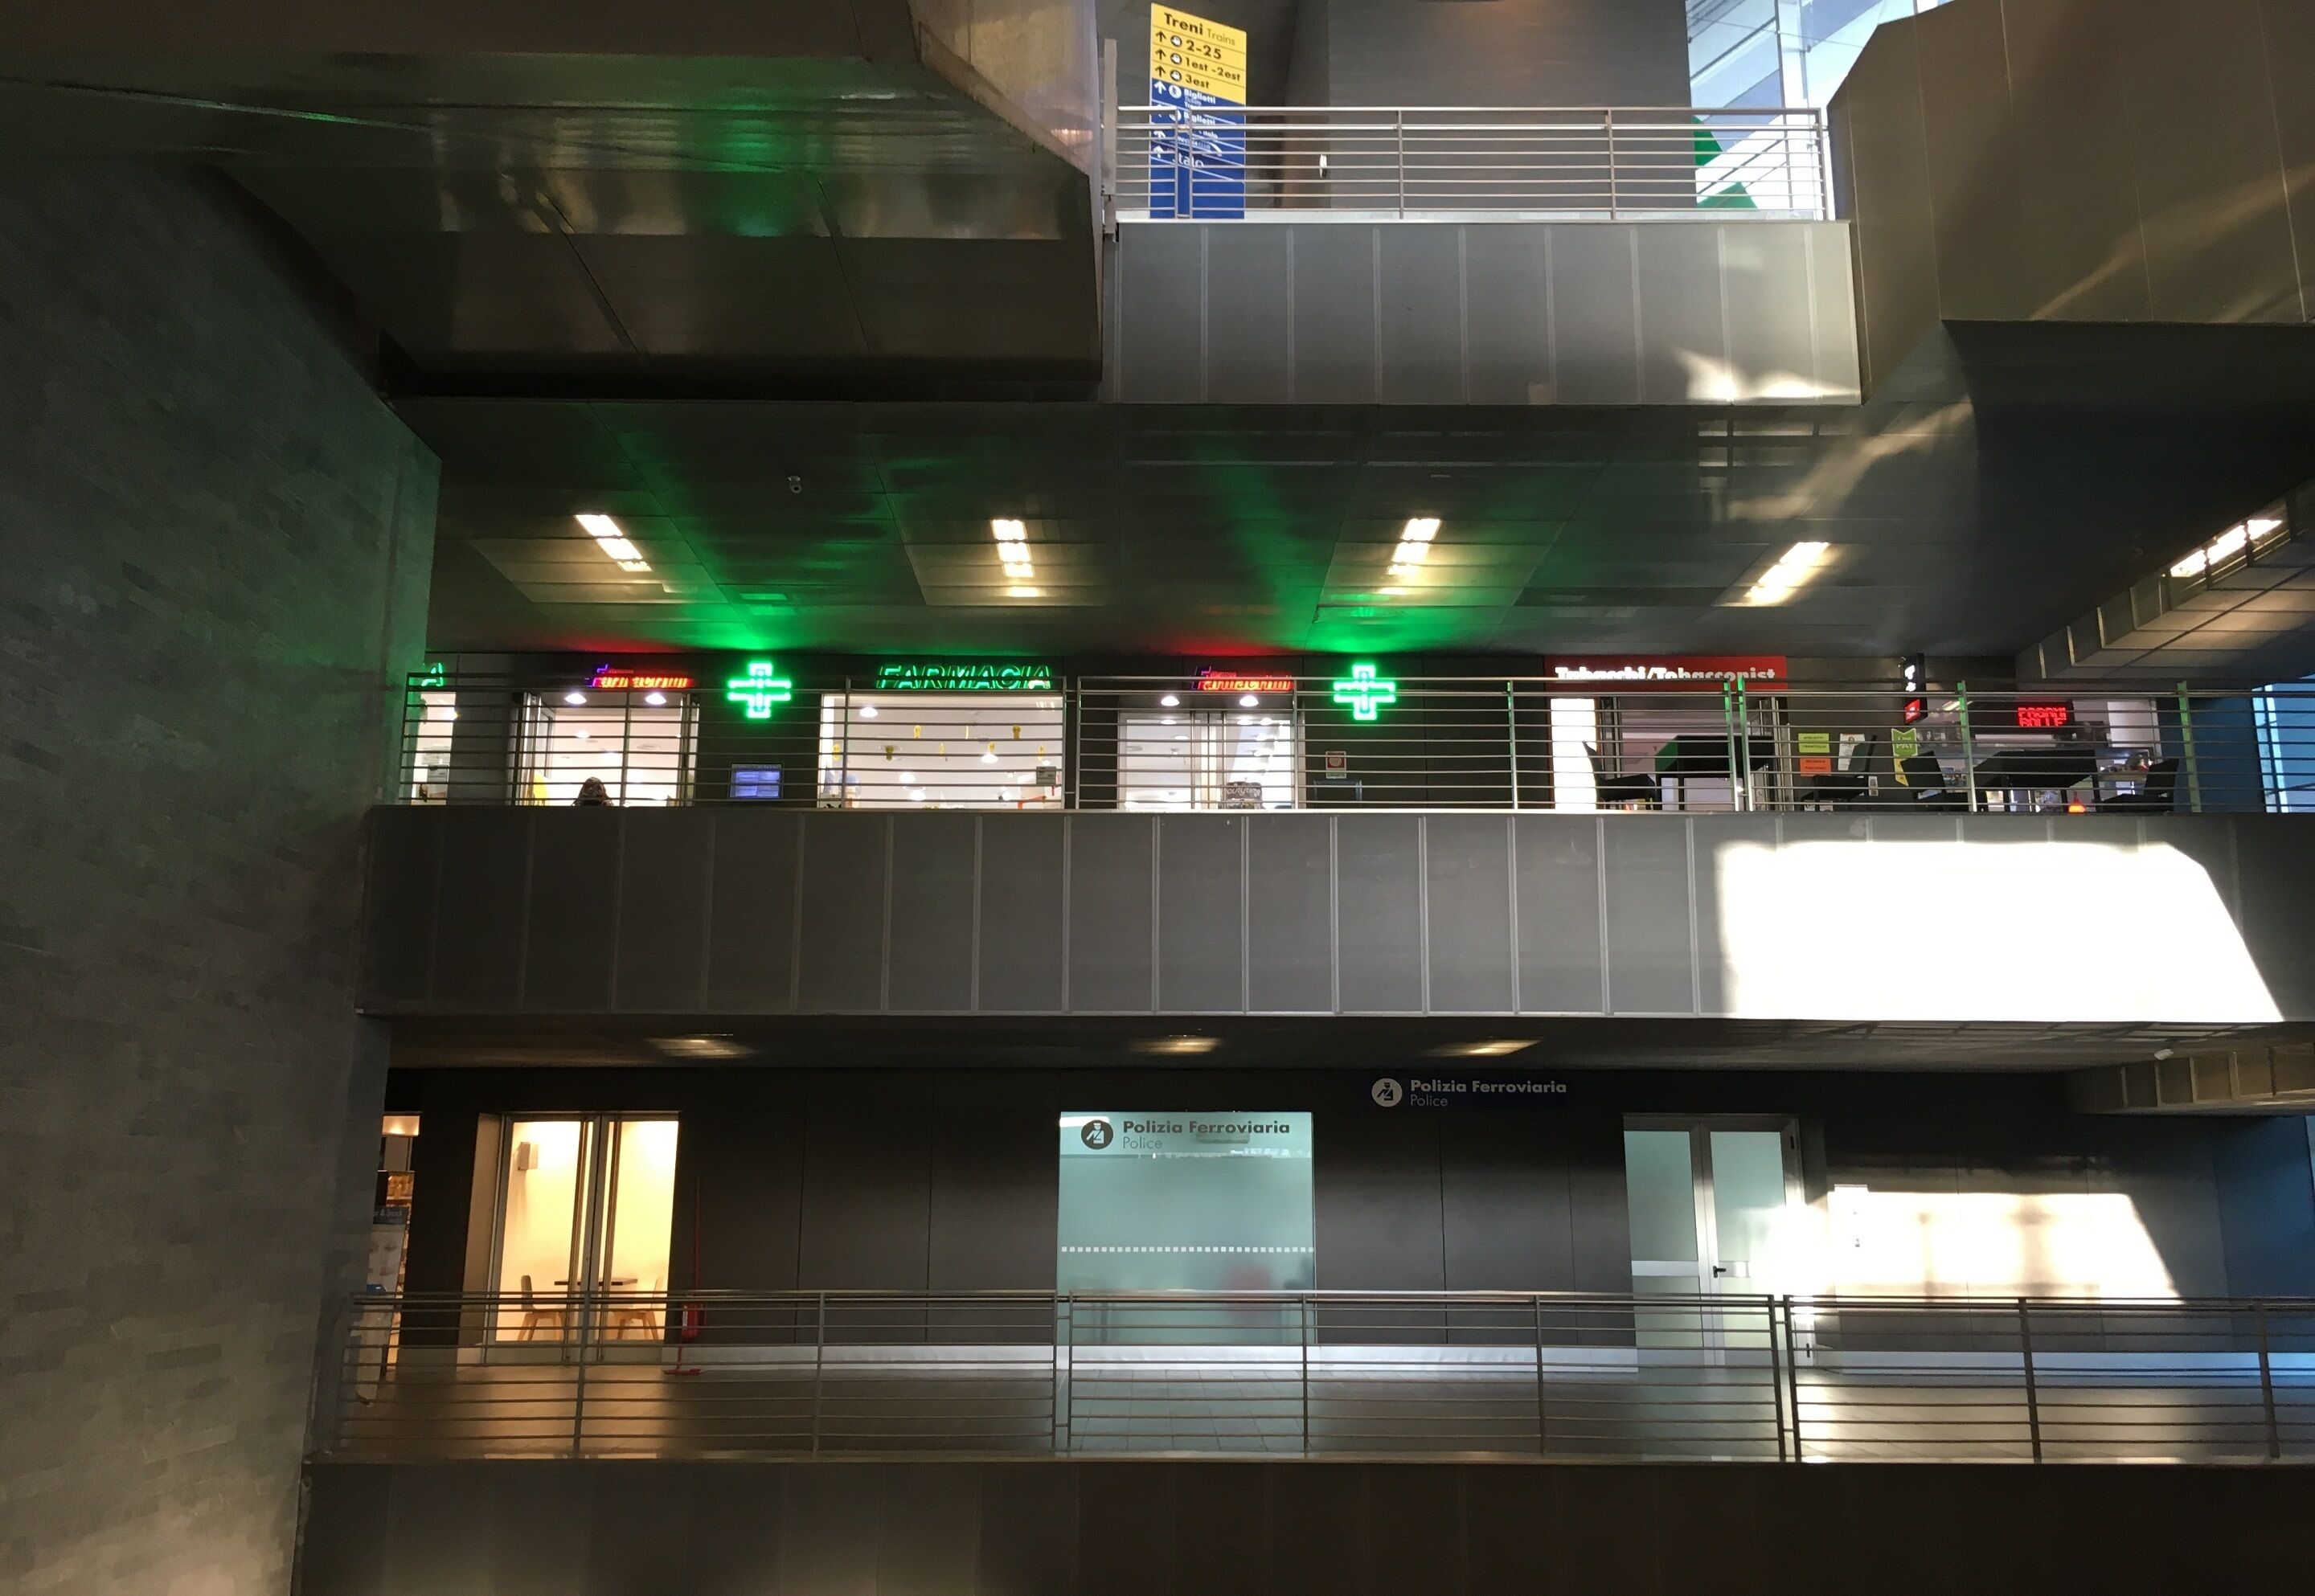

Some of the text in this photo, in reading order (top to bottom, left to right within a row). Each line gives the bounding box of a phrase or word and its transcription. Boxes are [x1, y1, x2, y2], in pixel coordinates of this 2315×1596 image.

[1164, 12, 1235, 46] Treni Trains
[1185, 56, 1208, 72] 1est
[1185, 74, 1210, 88] 3est
[1184, 88, 1216, 104] Biglietti
[1184, 110, 1216, 125] Bglietti
[876, 665, 1051, 689] FARMACIA
[1411, 1079, 1567, 1094] Polizia Ferroviaria
[1411, 1094, 1448, 1107] Police
[1123, 1120, 1290, 1134] Polizia Ferroviaria
[1123, 1136, 1163, 1149] Police
